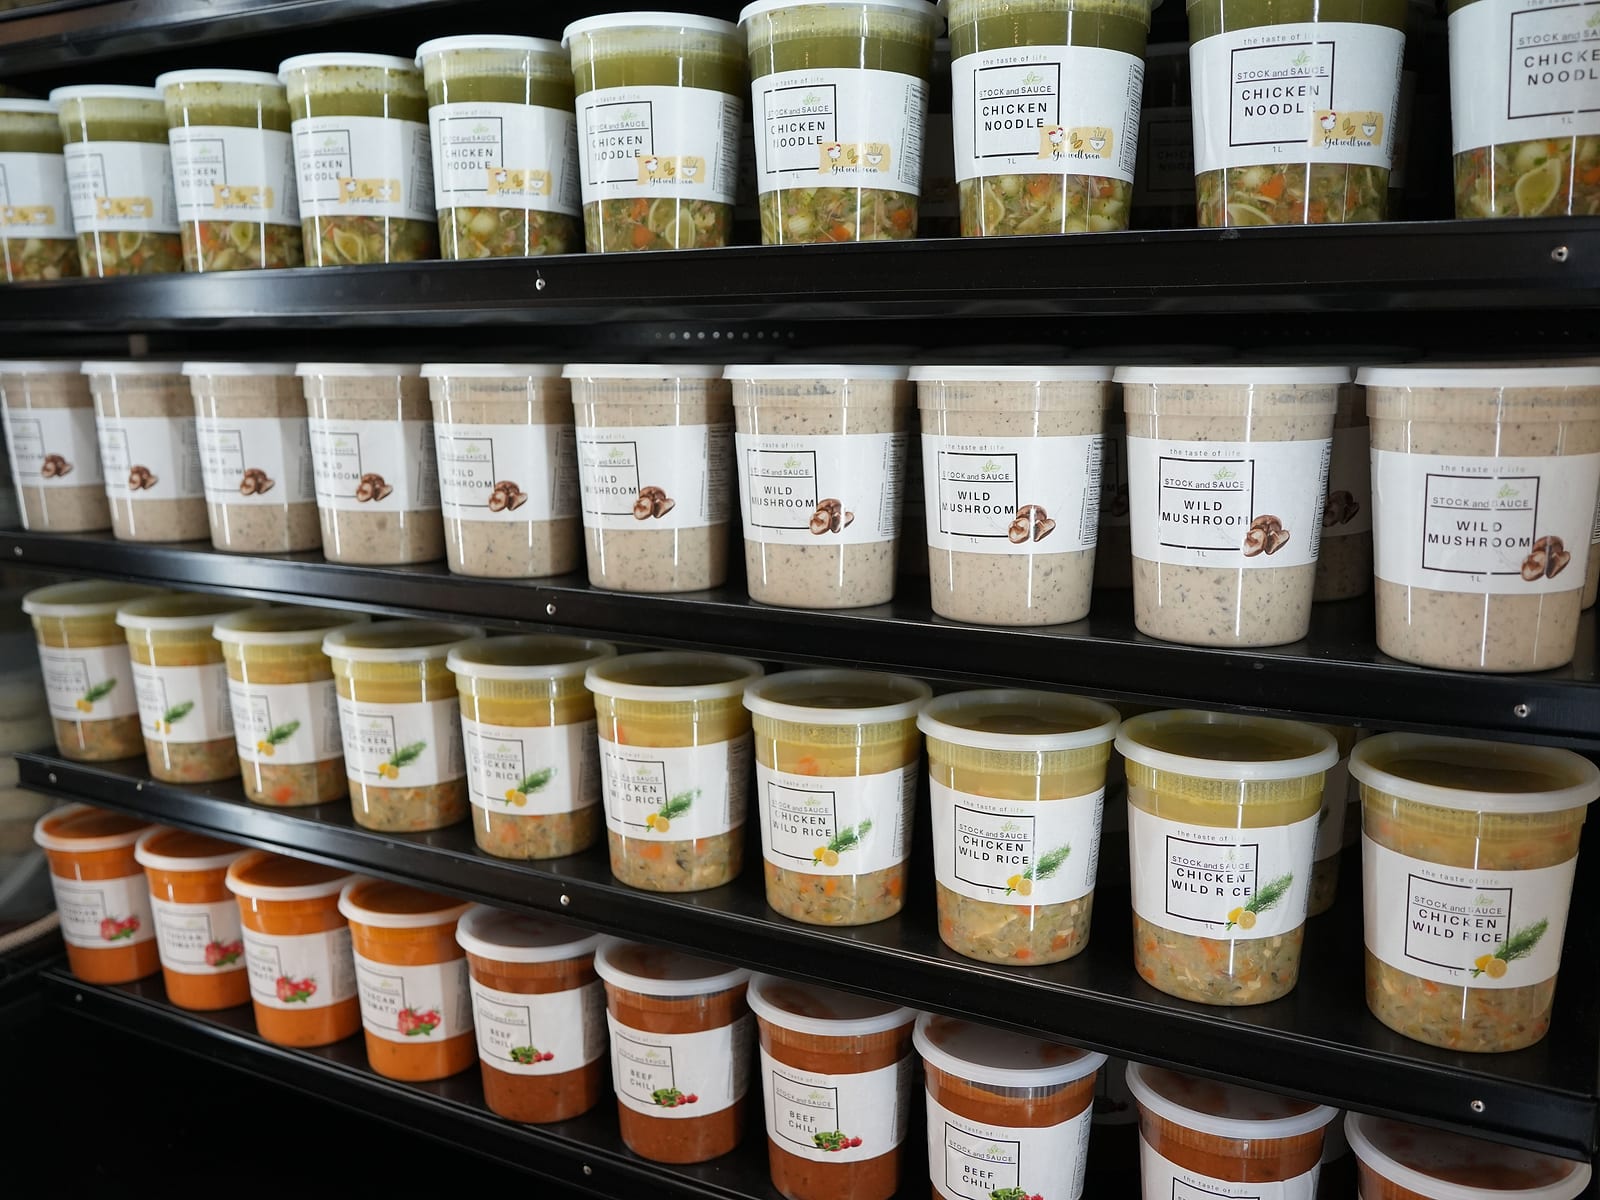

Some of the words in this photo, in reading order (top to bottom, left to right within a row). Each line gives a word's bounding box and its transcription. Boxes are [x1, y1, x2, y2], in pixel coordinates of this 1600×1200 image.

[1244, 38, 1257, 46] the
[1519, 33, 1560, 45] STOCK
[1562, 32, 1580, 41] and
[997, 56, 1017, 64] taste
[1237, 70, 1270, 80] STOCK
[1272, 69, 1288, 78] and
[1291, 67, 1325, 76] SAUCE
[1021, 86, 1052, 94] SAUCE
[1242, 85, 1319, 101] CHICKEN
[802, 105, 829, 113] SAUCE
[983, 102, 1047, 116] CHICKEN
[1244, 102, 1316, 117] NOODL
[985, 118, 1044, 131] NOODLE
[302, 160, 342, 170] CHCKEN
[1165, 478, 1193, 487] STOCK
[585, 486, 636, 495] MSHROOM
[764, 486, 792, 495] WILD
[958, 491, 990, 500] WILD
[752, 497, 814, 508] MUSHROOM
[942, 503, 1014, 514] MUSHROOM
[1184, 500, 1222, 511] WILD
[1433, 497, 1469, 506] STOCK
[1472, 500, 1489, 508] and
[1457, 521, 1502, 532] WILD
[1428, 534, 1530, 547] MUSHROOM
[496, 772, 520, 780] RICE
[612, 780, 657, 793] CICKEN
[977, 803, 996, 811] taste
[773, 821, 797, 833] WILD
[803, 828, 832, 837] RICE
[959, 824, 984, 835] STOCK
[1177, 830, 1190, 838] the
[1194, 833, 1215, 841] taste
[963, 835, 1024, 851] CHICKEN
[959, 846, 990, 861] WILD
[996, 855, 1029, 864] RICE
[1172, 855, 1202, 867] STOCK
[1177, 867, 1246, 883] CHICKEN
[1421, 869, 1435, 878] the
[1440, 874, 1464, 883] taste
[1172, 879, 1208, 894] WILD
[1216, 887, 1251, 896] RCE
[1414, 896, 1447, 910] STOCK
[1450, 905, 1465, 913] and
[1419, 909, 1497, 928] CHICKEN
[1413, 920, 1454, 938] WILD
[630, 1070, 652, 1080] BEEF
[630, 1078, 655, 1090] CHILI
[776, 1087, 794, 1099] STOCK
[789, 1111, 815, 1123] BEEF
[789, 1120, 817, 1133] CHILI
[964, 1125, 982, 1134] taste
[949, 1140, 972, 1153] STOCK
[986, 1154, 1012, 1162] SAUCE
[964, 1165, 994, 1179] BEEF
[963, 1175, 995, 1190] CHILI
[1183, 1175, 1195, 1183] the
[1198, 1181, 1219, 1191] taste
